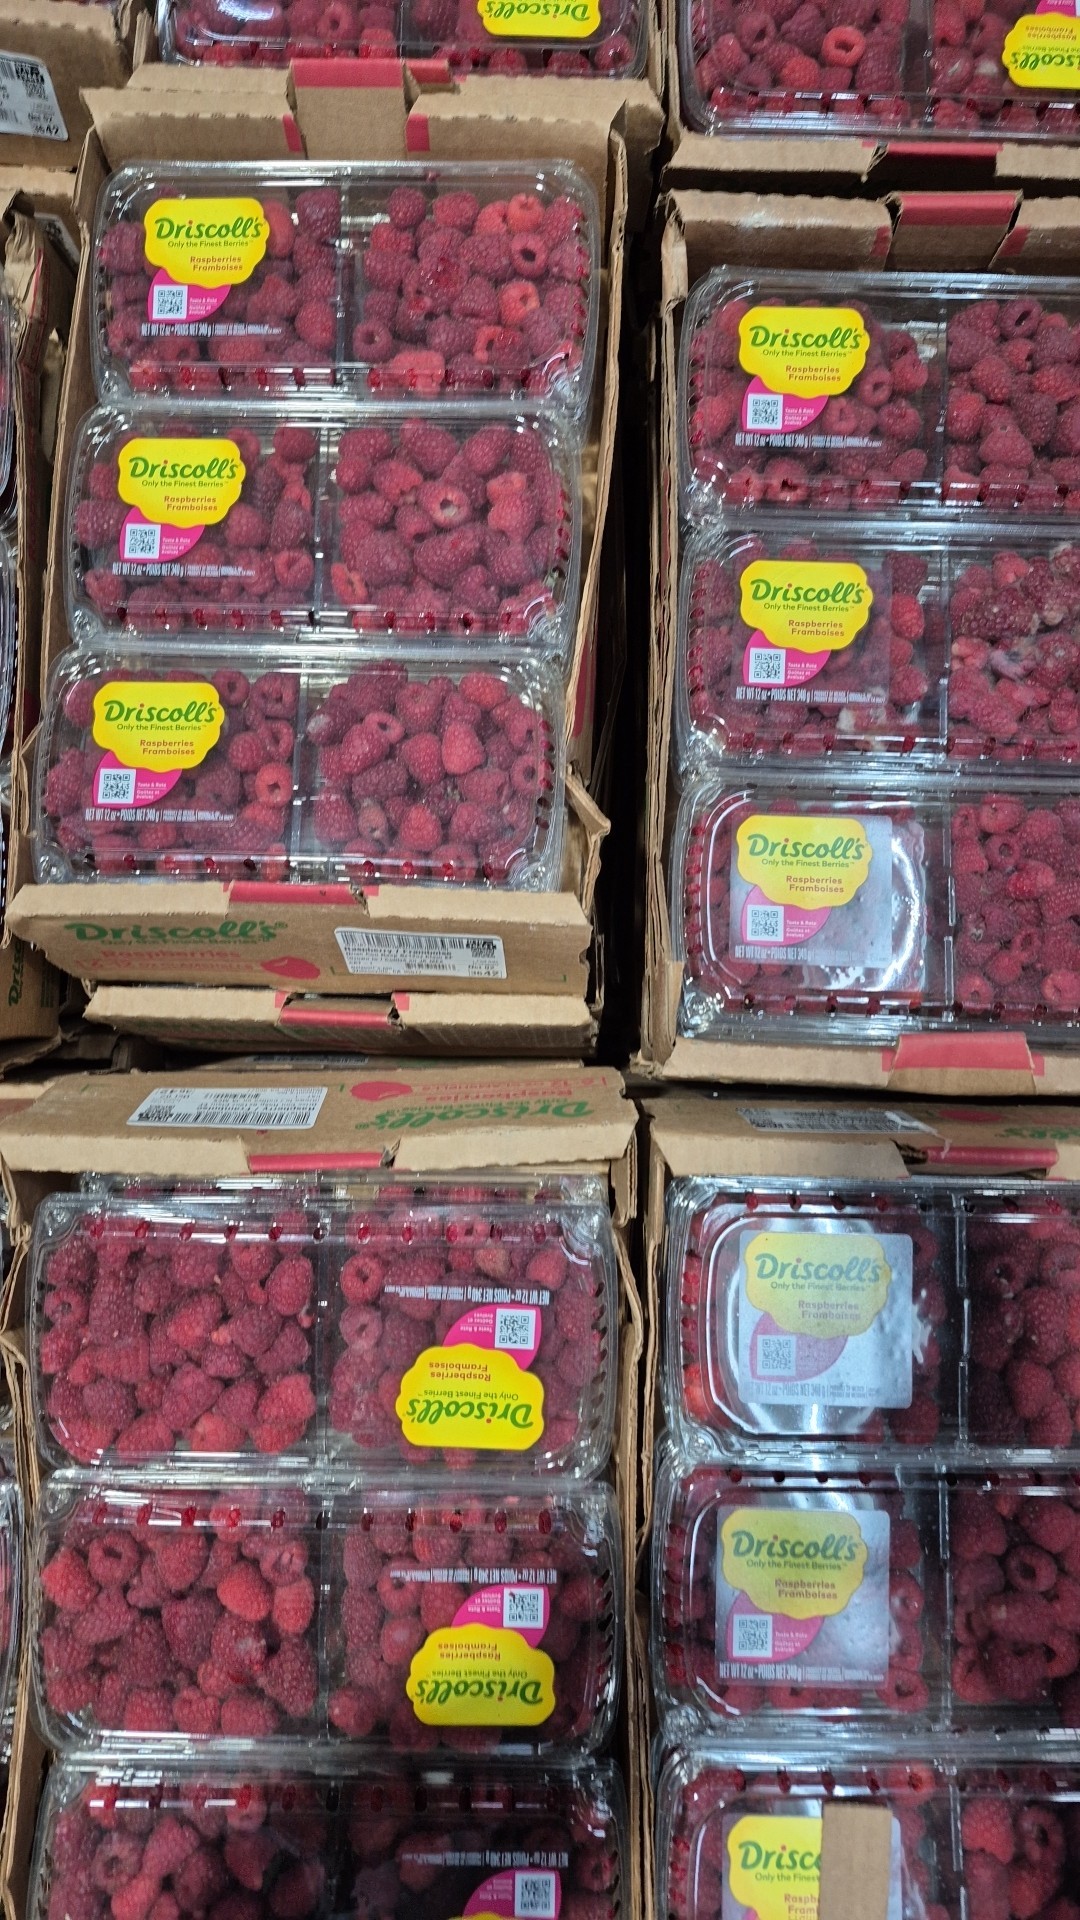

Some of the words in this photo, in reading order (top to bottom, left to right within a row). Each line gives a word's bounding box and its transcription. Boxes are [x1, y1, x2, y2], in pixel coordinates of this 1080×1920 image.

[484, 0, 591, 21] Driscoll's
[1026, 26, 1074, 34] Framboises
[155, 217, 264, 239] Driscoll's
[168, 241, 185, 249] Only
[190, 256, 242, 264] Raspberries
[193, 264, 243, 272] Framboises
[749, 326, 863, 350] Driscoll's
[762, 350, 781, 358] Only
[821, 350, 847, 358] Berries
[786, 365, 840, 374] Raspberries
[789, 374, 842, 382] Framboises
[129, 457, 239, 479] Driscoll's
[142, 480, 159, 488] Only
[164, 496, 217, 504] Raspberries
[166, 504, 218, 512] Framboises
[750, 579, 865, 604] Driscoll's
[764, 603, 782, 611] Only
[797, 604, 821, 612] Finest
[788, 620, 844, 629] Raspberries
[791, 628, 845, 637] Framboises
[736, 686, 745, 700] NET
[746, 687, 755, 700] WT
[755, 687, 761, 700] 12
[761, 689, 768, 701] oz
[771, 688, 786, 701] POIDS
[787, 688, 797, 701] NET
[797, 688, 807, 702] 340
[807, 691, 810, 703] g
[104, 700, 218, 723] Driscoll's
[117, 724, 134, 732] Only
[140, 740, 194, 748] Raspberries
[86, 808, 95, 821] NET
[96, 808, 104, 821] WT
[105, 808, 110, 821] 12
[110, 810, 116, 821] oz
[120, 808, 136, 821] POIDS
[136, 809, 145, 821] NET
[146, 809, 156, 821] 340
[156, 811, 160, 823] g
[747, 834, 865, 860] Driscoll's
[762, 859, 781, 867] Only
[822, 860, 849, 868] Berries
[786, 876, 842, 884] Raspberries
[789, 885, 844, 893] Framboises
[426, 1089, 573, 1103] Raspberries
[754, 1253, 881, 1283] Driscoll's
[468, 1285, 471, 1299] g
[472, 1287, 483, 1303] 340
[483, 1287, 493, 1303] NET
[494, 1288, 511, 1304] POIDS
[515, 1289, 521, 1302] oz
[522, 1289, 528, 1305] 12
[529, 1289, 538, 1305] WT
[539, 1290, 550, 1306] NET
[429, 1362, 488, 1372] Framboises
[430, 1372, 491, 1381] Raspberries
[424, 1390, 453, 1398] Berries
[499, 1393, 519, 1401] Only
[406, 1399, 534, 1428] Driscoll's
[731, 1530, 858, 1561] Driscoll's
[746, 1560, 766, 1569] Only
[768, 1560, 782, 1568] the
[784, 1561, 810, 1569] Finest
[812, 1562, 841, 1570] Berries
[774, 1578, 836, 1590] Raspberries
[778, 1589, 838, 1600] Framboises
[438, 1643, 498, 1651] Framboises
[440, 1652, 501, 1662] Raspberries
[432, 1670, 462, 1678] Berries
[465, 1670, 491, 1678] Finest
[508, 1671, 528, 1679] Only
[415, 1679, 543, 1705] Driscoll's
[755, 1872, 775, 1882] Only
[777, 1873, 790, 1881] the
